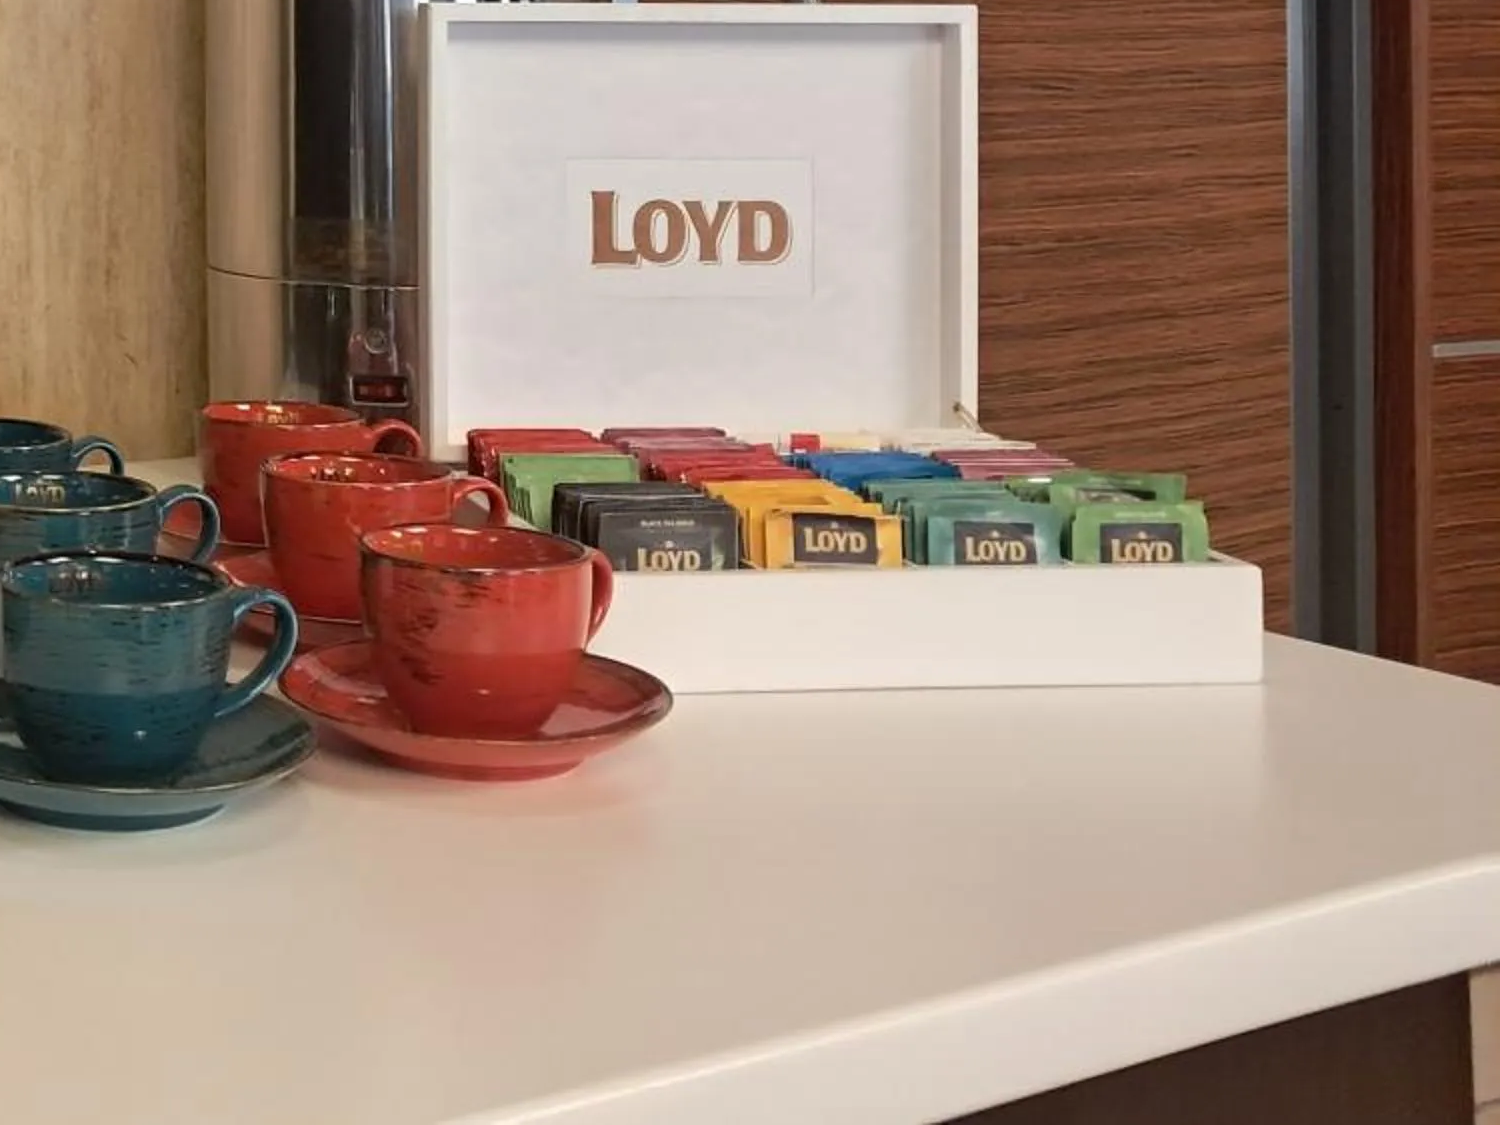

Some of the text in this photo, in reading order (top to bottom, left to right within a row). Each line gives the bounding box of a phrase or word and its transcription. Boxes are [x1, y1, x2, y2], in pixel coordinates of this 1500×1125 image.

[591, 190, 794, 269] LOYD
[804, 527, 867, 552] LOYD
[964, 535, 1027, 562] LOYD
[1111, 537, 1173, 563] LOYD
[637, 547, 700, 571] LOYD
